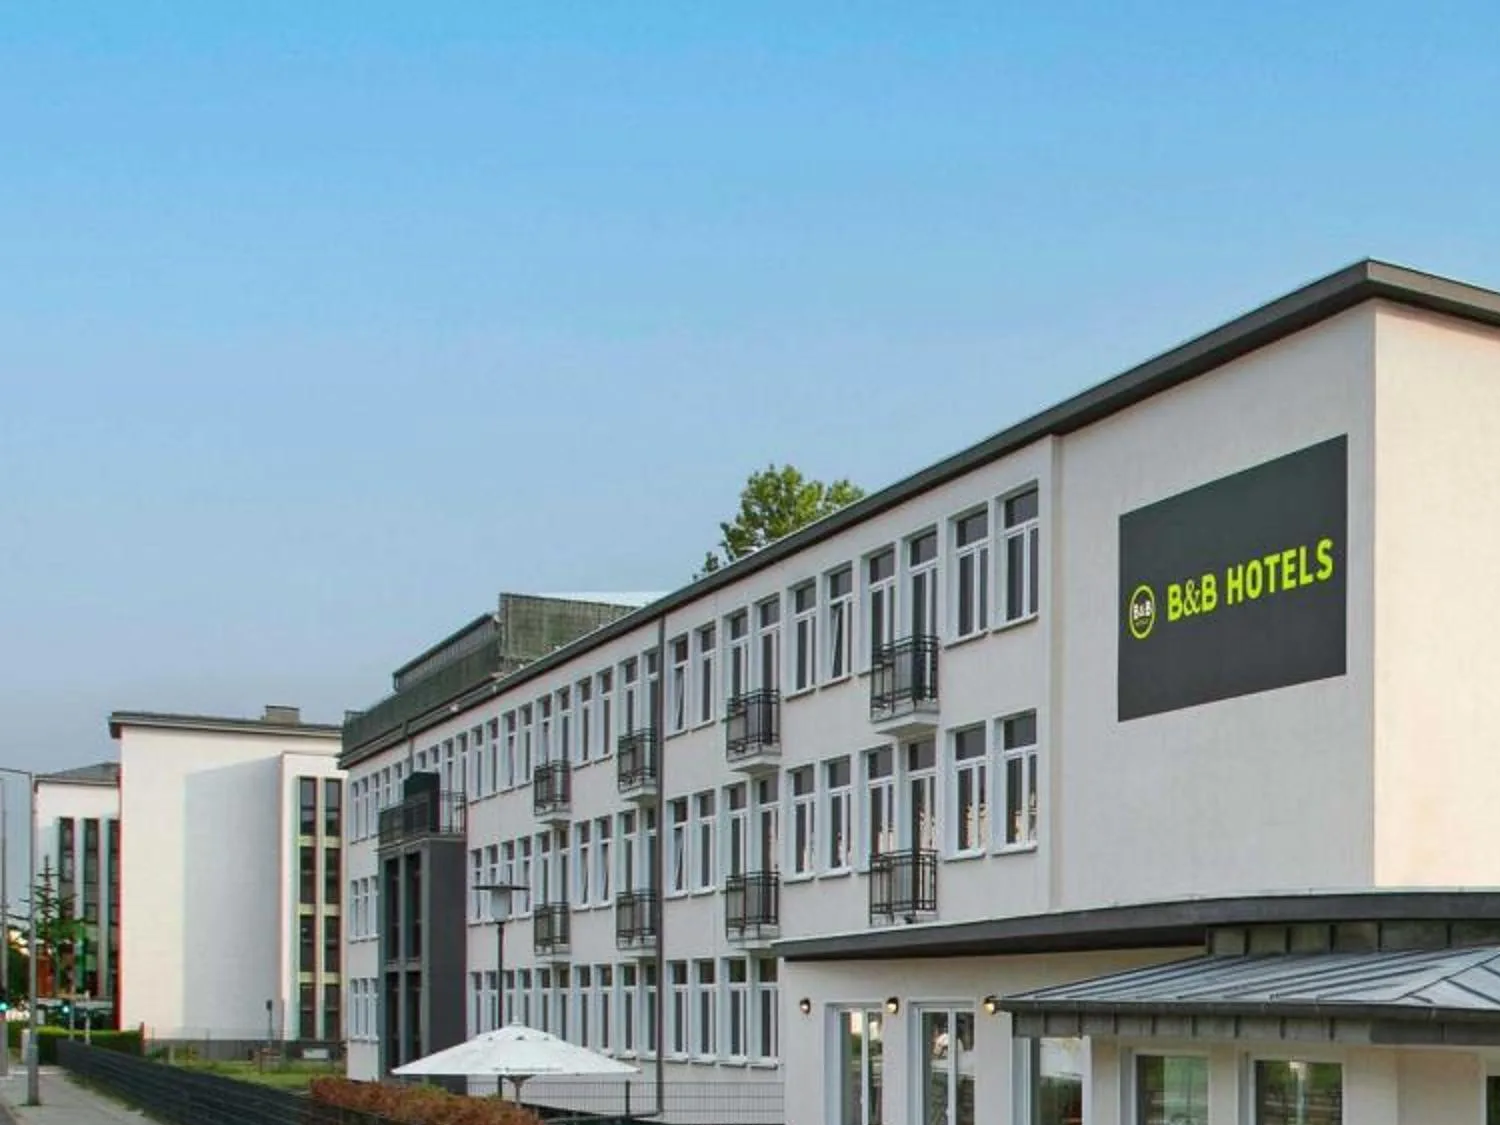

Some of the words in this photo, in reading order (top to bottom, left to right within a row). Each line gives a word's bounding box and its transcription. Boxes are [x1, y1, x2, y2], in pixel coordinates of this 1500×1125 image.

[1167, 573, 1217, 622] B&B
[1227, 538, 1334, 605] HOTELS
[1133, 600, 1153, 620] B&B
